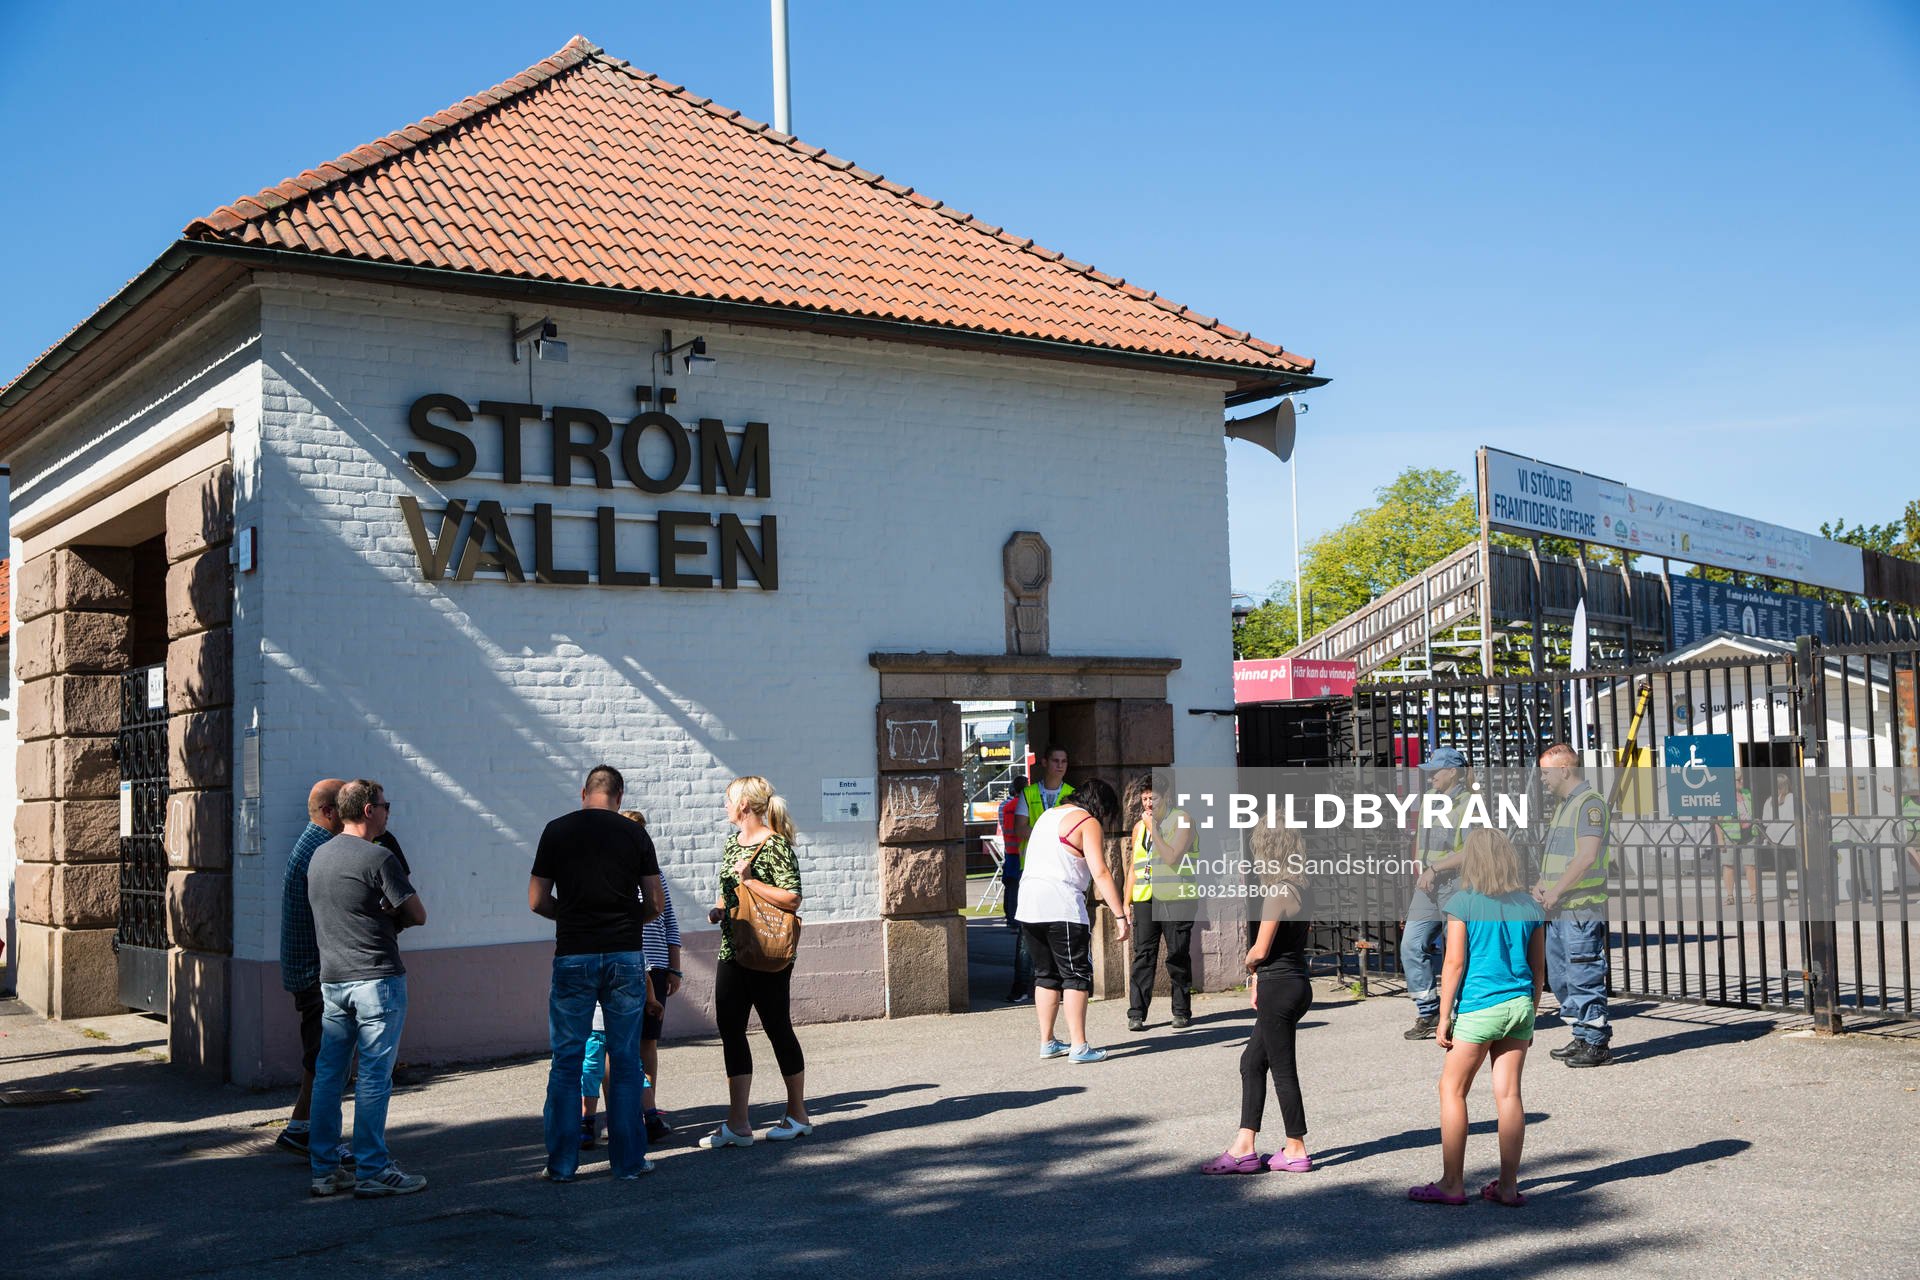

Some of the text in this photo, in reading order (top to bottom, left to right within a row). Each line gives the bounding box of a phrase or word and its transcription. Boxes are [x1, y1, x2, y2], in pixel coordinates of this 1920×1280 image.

[408, 385, 771, 498] STRÖM
[1518, 468, 1528, 493] VI
[1530, 470, 1573, 503] STÖDJER
[1494, 493, 1596, 537] FRAMTIDENS GIFFARE
[399, 496, 779, 590] VALLEN
[1233, 665, 1286, 682] vinna på
[1293, 666, 1356, 682] Här kan du vinna på
[1681, 791, 1722, 807] ENTRÉ
